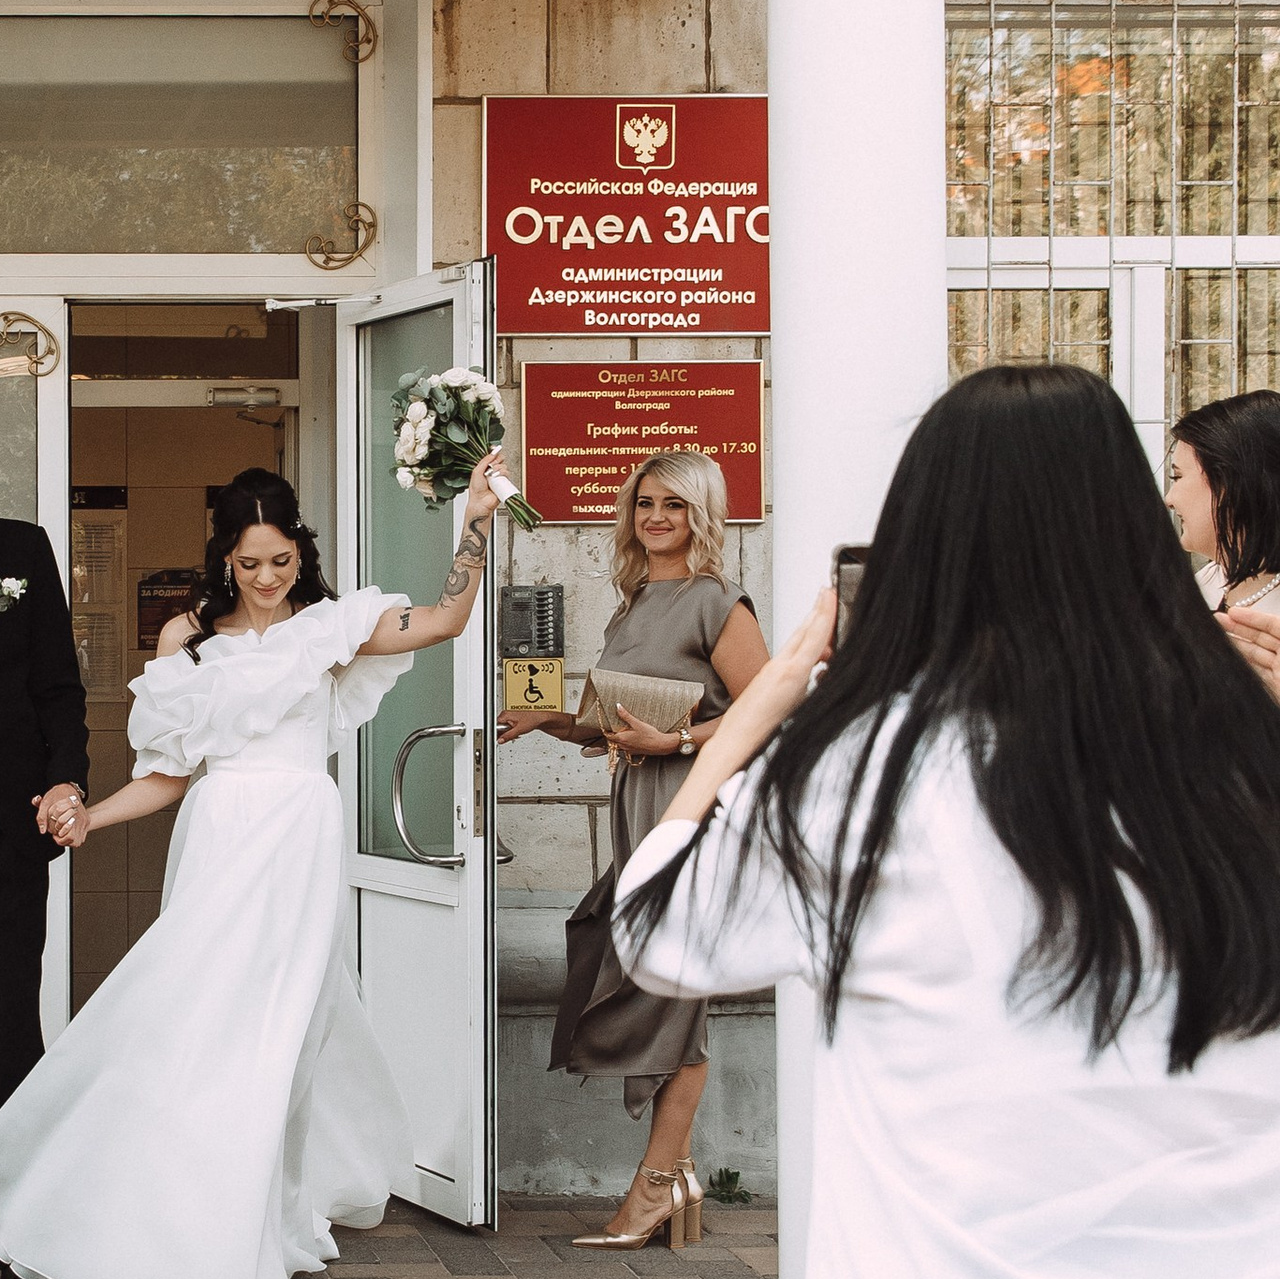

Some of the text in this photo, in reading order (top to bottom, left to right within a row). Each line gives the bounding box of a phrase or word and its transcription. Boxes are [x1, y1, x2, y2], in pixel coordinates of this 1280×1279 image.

[530, 177, 758, 199] Российская Федерация
[505, 205, 769, 250] Отдел ЗАГС
[561, 267, 724, 285] администрации
[528, 287, 756, 307] Дзержинского района
[584, 310, 701, 329] Волгограда
[598, 369, 688, 385] Отдел ЗАГС
[551, 387, 735, 400] администрации Дзержинского района
[615, 401, 670, 412] Волгограда
[587, 422, 698, 439] График работы:
[529, 446, 661, 457] понедельник-пятница
[702, 445, 719, 455] до
[722, 442, 757, 454] 17.30
[565, 466, 618, 477] перерыв
[620, 466, 627, 474] с
[570, 483, 620, 496] суббота
[572, 505, 620, 514] выходн
